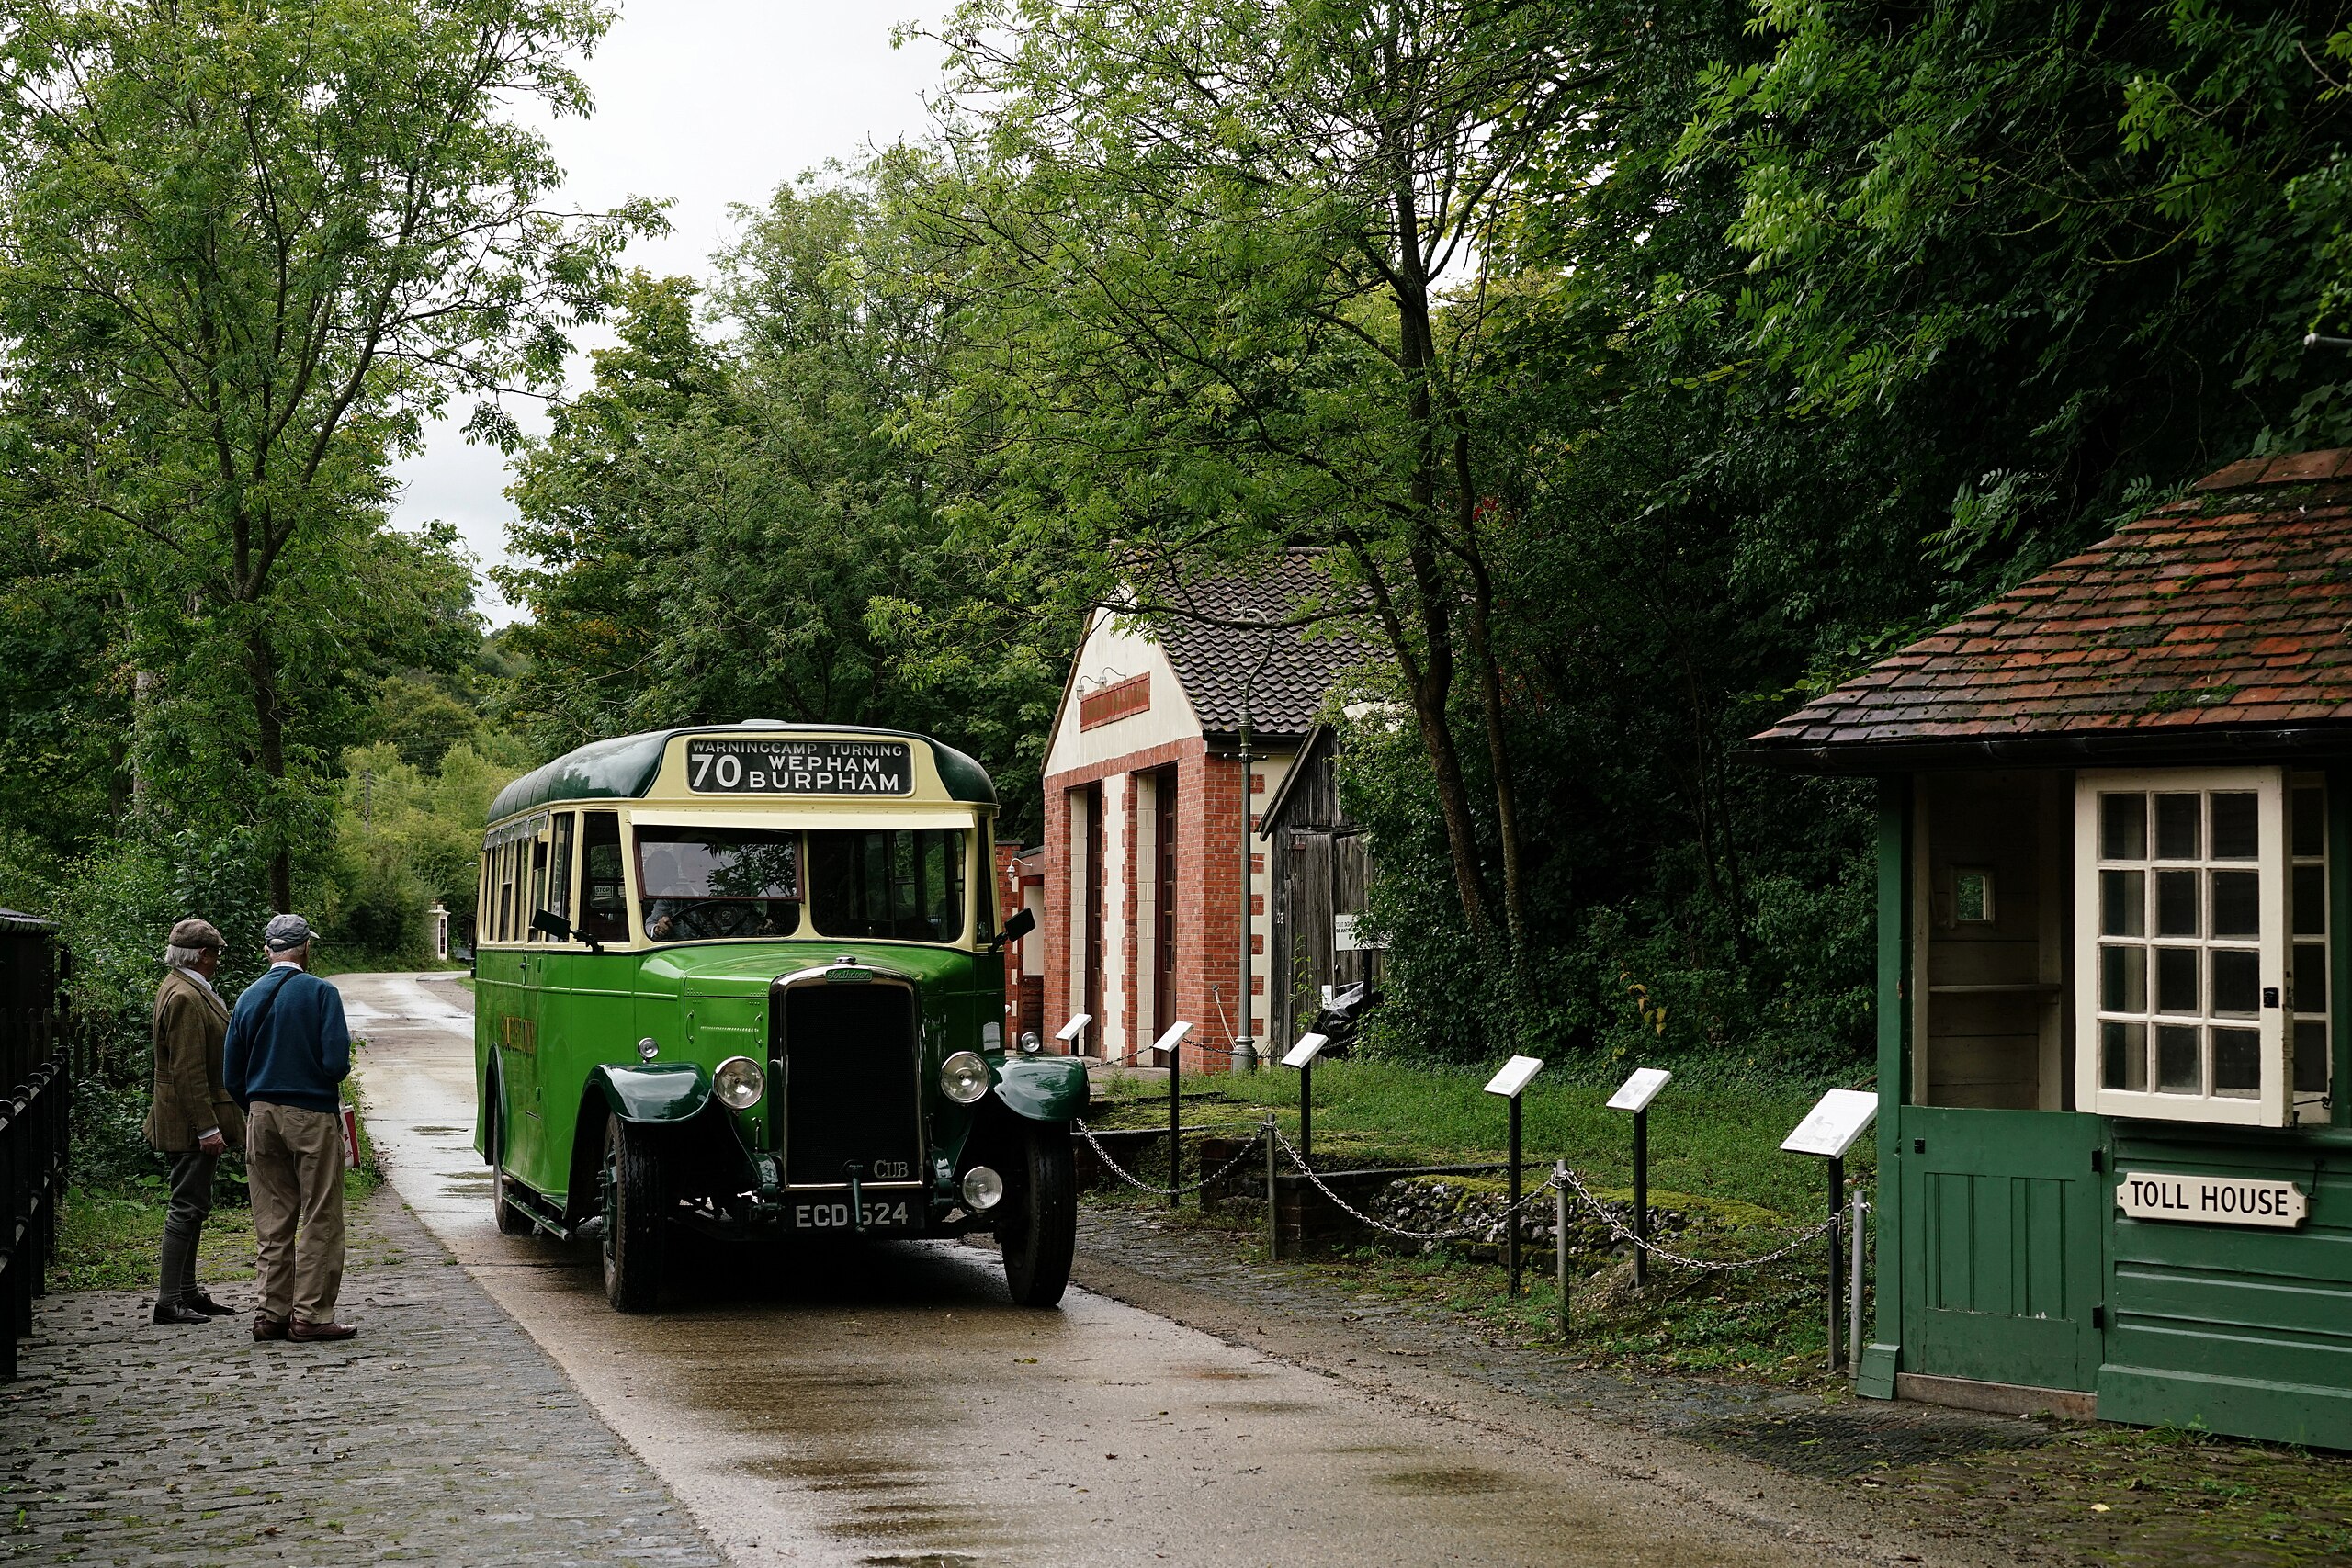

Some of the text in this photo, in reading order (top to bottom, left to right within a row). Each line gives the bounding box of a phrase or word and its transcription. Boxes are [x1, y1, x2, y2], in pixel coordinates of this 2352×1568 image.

[692, 741, 903, 757] WARNINGCAMP TURNING
[691, 754, 741, 788] 70
[768, 755, 881, 773] WEPHAM
[749, 771, 899, 791] BURPHAM
[874, 1159, 910, 1179] CUB
[2130, 1181, 2289, 1216] TOLL HOUSE
[796, 1201, 909, 1228] ECD 524
